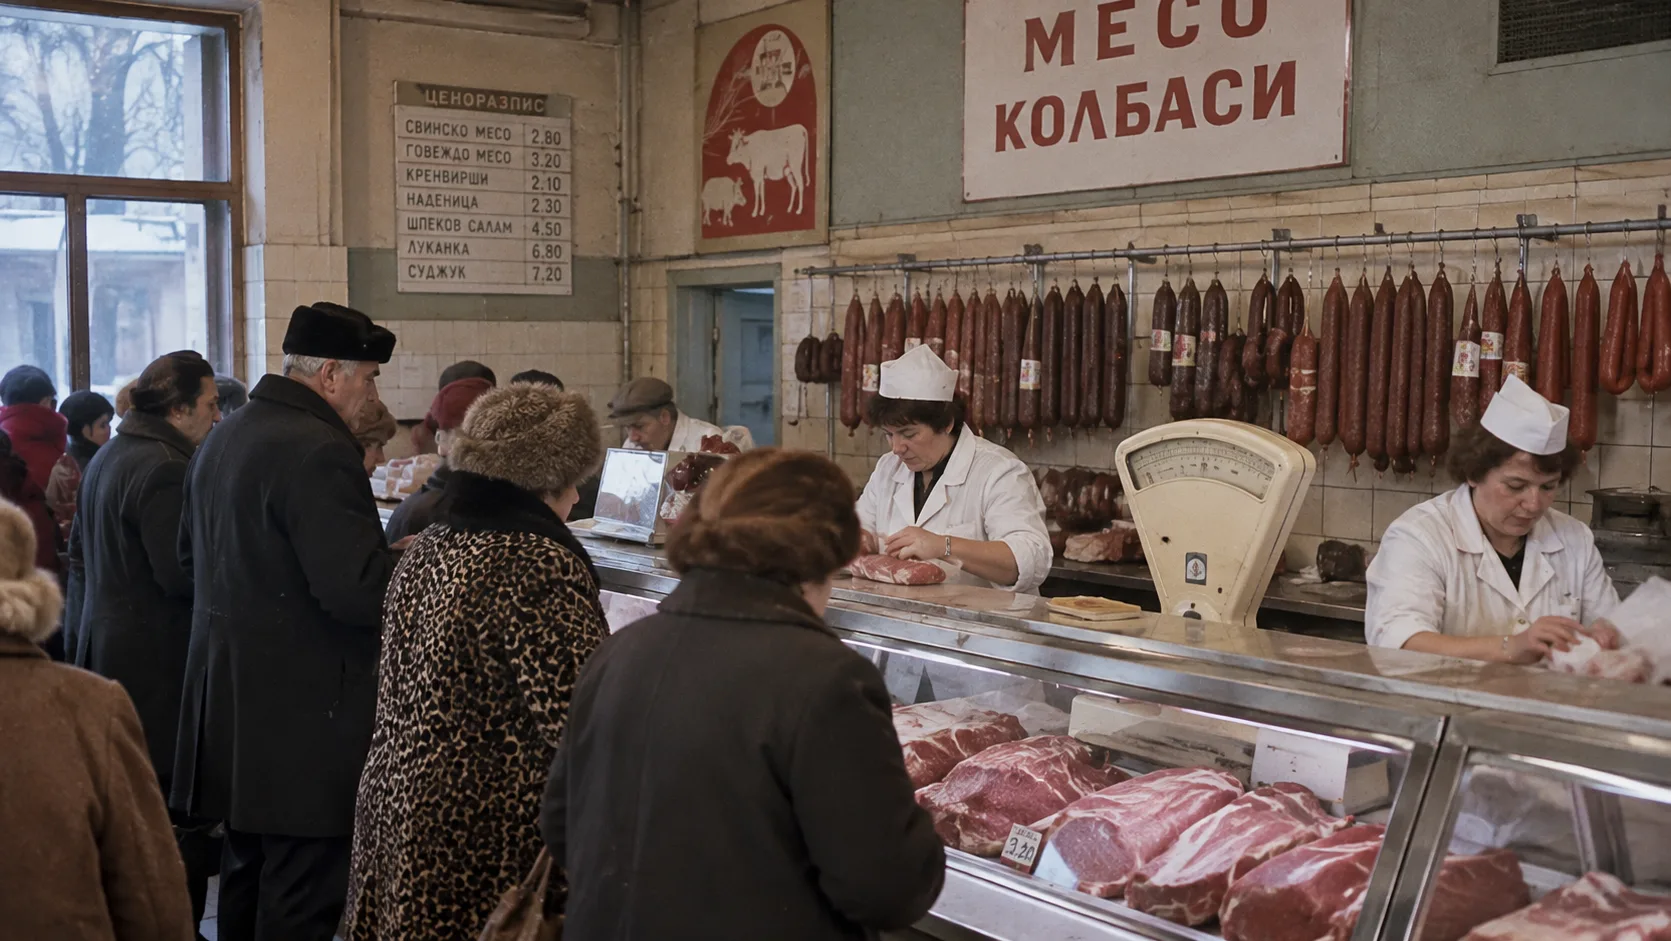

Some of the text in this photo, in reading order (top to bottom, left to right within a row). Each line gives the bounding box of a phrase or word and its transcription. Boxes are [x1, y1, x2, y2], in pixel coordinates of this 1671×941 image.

[1023, 0, 1268, 72] МЕСО
[424, 89, 546, 112] ЦЕНОРАЗПИС
[994, 60, 1297, 153] КОЛБАСИ
[405, 119, 561, 146] СВИНСКО МЕСО 2.80
[406, 143, 561, 169] ГОВЕЖДО МЕСО 3.20
[406, 168, 561, 191] КРЕНВИРШИ 2.10
[407, 192, 562, 214] НАДЕНИЦА 2.30
[407, 216, 562, 237] ШПЕКОВ САЛАМ 4.50
[407, 240, 562, 260] ЛУКАНКА 6.80
[408, 264, 563, 282] СУДЖУК 7.20
